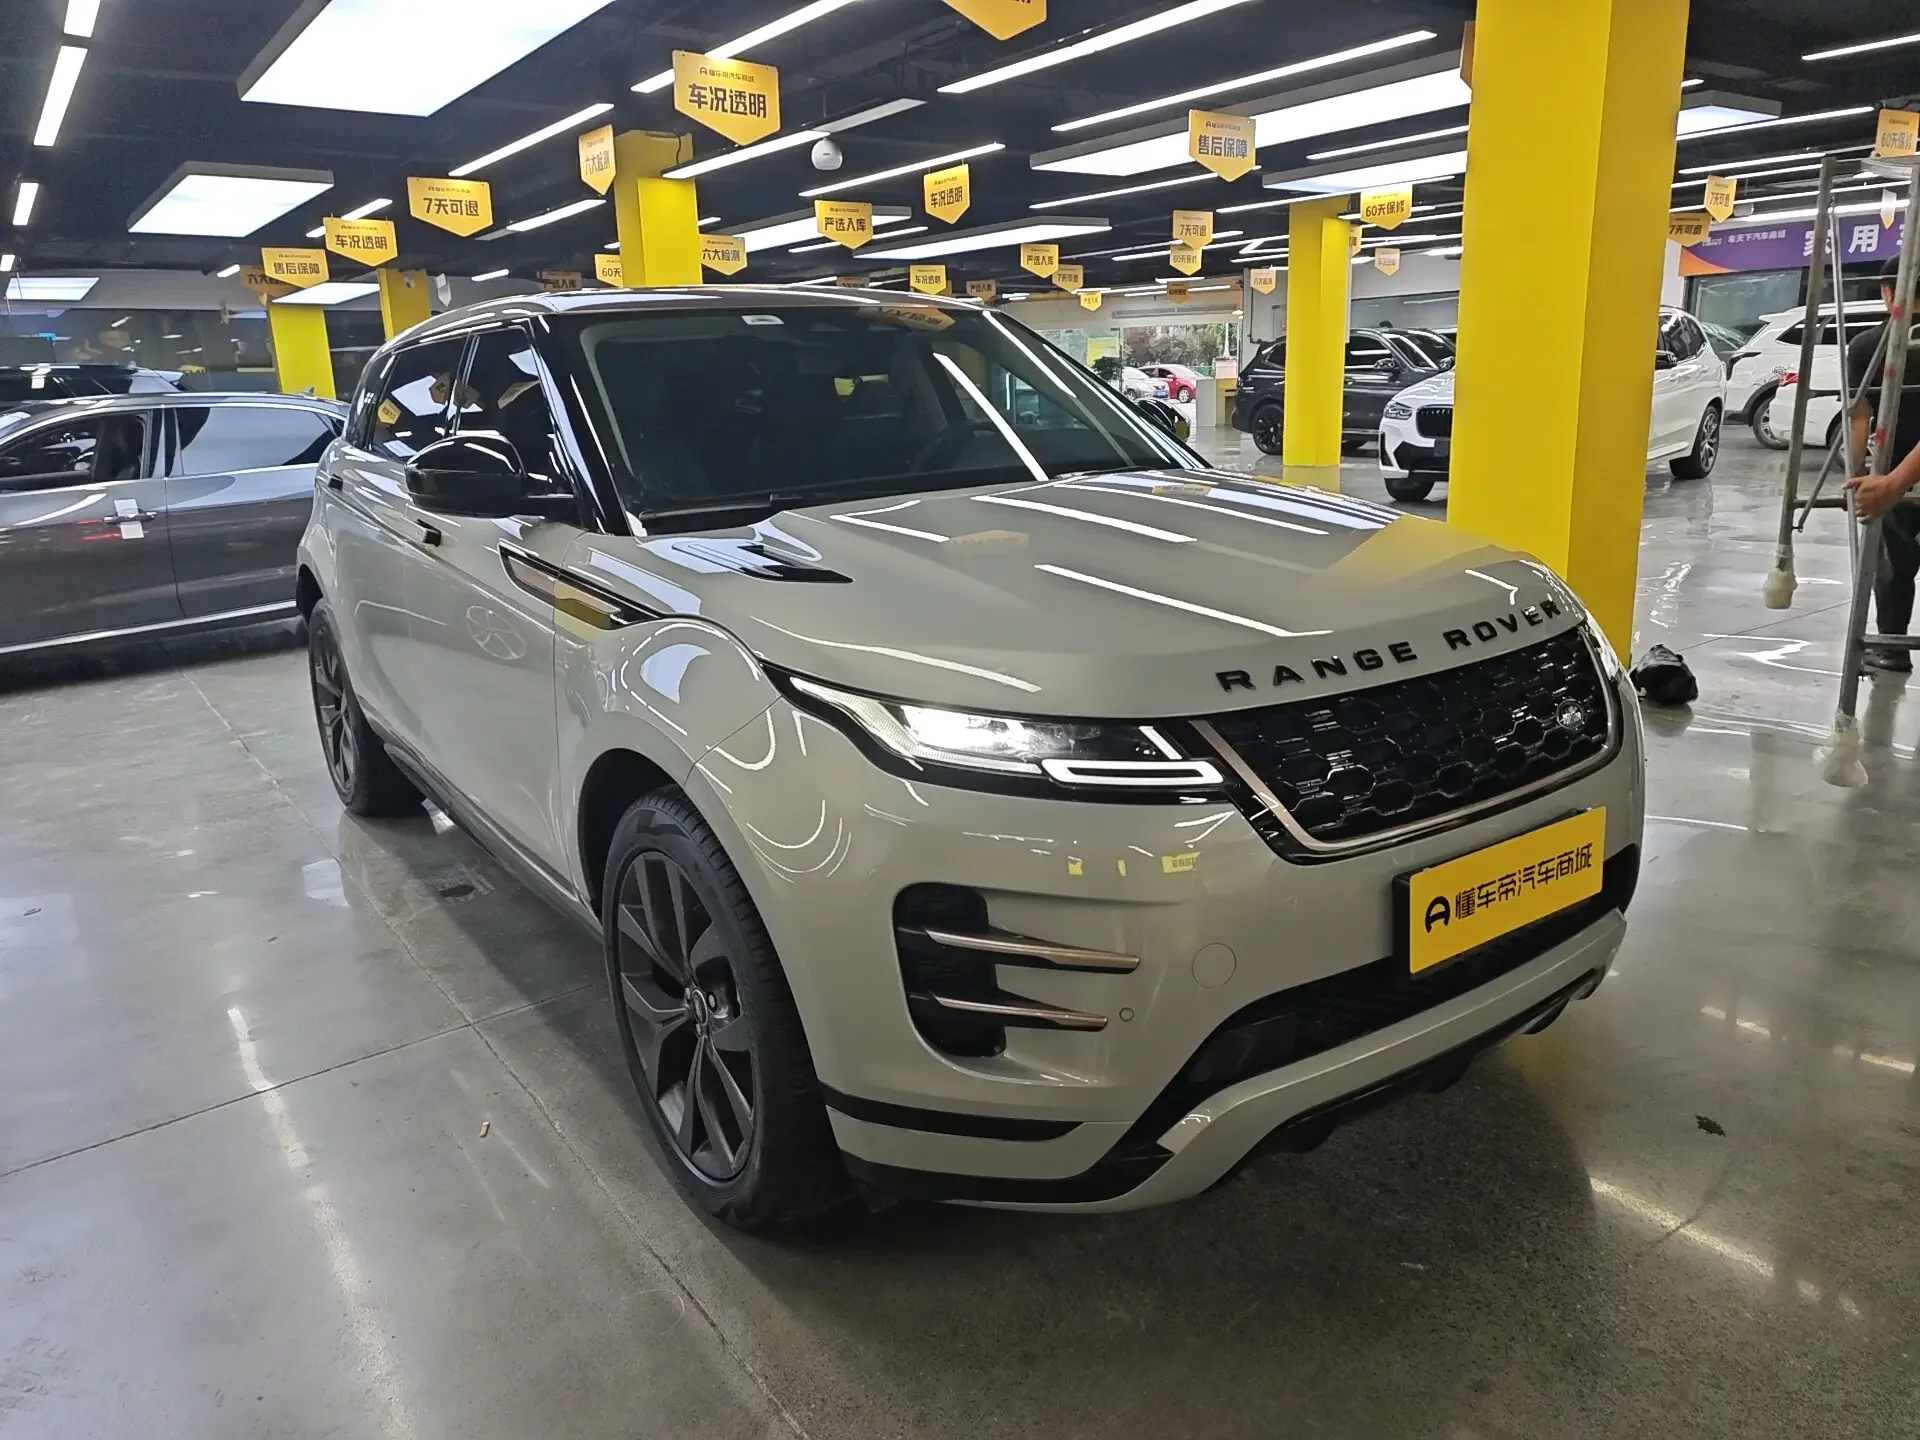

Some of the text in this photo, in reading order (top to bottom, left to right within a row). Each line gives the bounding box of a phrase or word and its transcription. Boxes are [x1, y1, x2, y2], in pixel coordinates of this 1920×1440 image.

[688, 83, 767, 119] 车况透明
[1198, 134, 1248, 159] 售后保障
[930, 186, 963, 209] 车况透明
[423, 197, 480, 217] 7天可退
[1365, 200, 1405, 217] 60天保修
[824, 216, 867, 232] 严选入库
[1180, 224, 1207, 237] 7天可退
[335, 234, 388, 250] 车况透明
[702, 248, 741, 262] 六大检测
[1026, 255, 1054, 266] 严选入库
[273, 262, 321, 275] 售后保障
[1216, 599, 1562, 694] RANGE ROVER
[1455, 842, 1593, 921] 懂车帝汽车商城
